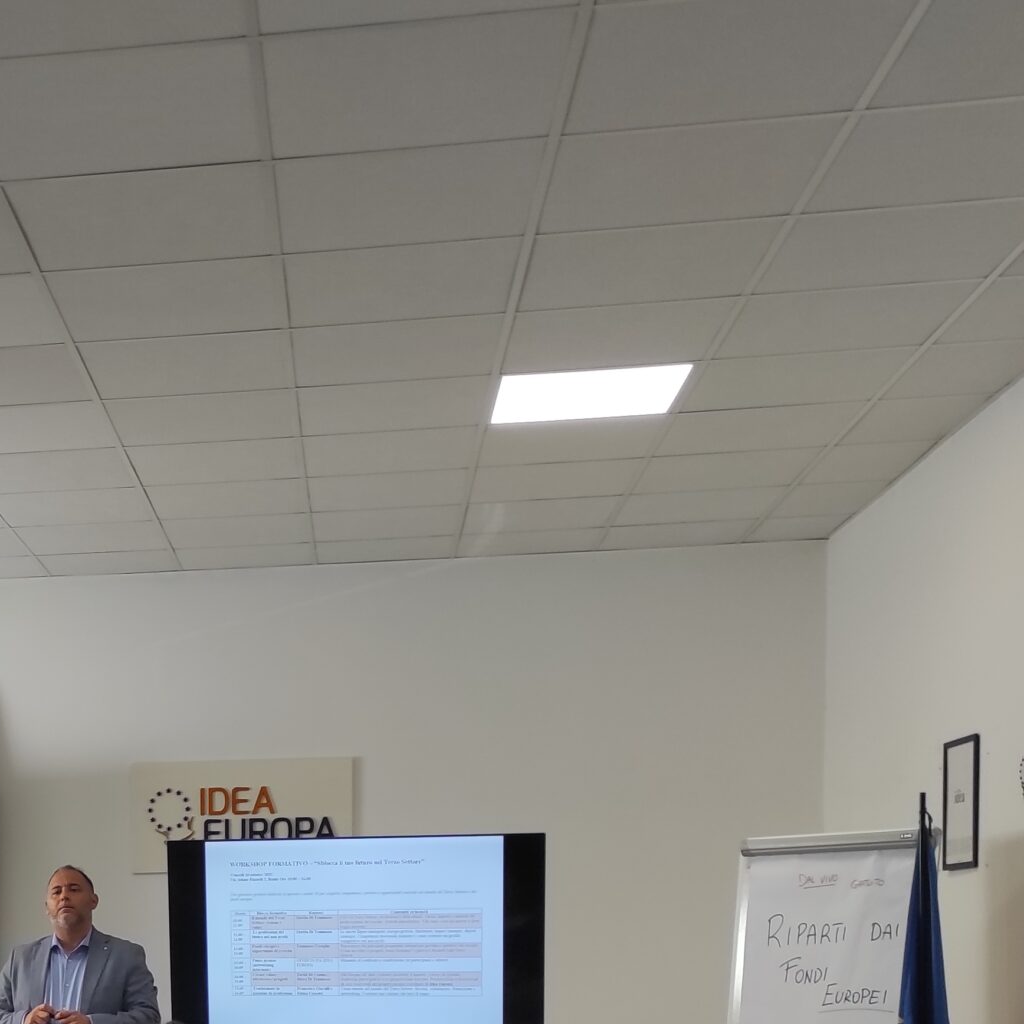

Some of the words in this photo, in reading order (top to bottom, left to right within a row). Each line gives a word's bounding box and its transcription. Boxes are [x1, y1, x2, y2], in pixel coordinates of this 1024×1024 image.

[199, 786, 276, 816] IDEA
[203, 816, 337, 840] EUROPA
[767, 913, 847, 948] RIPARTI
[870, 921, 899, 942] DAI
[779, 956, 829, 984] FONDI
[822, 982, 888, 1006] EUROPEI
